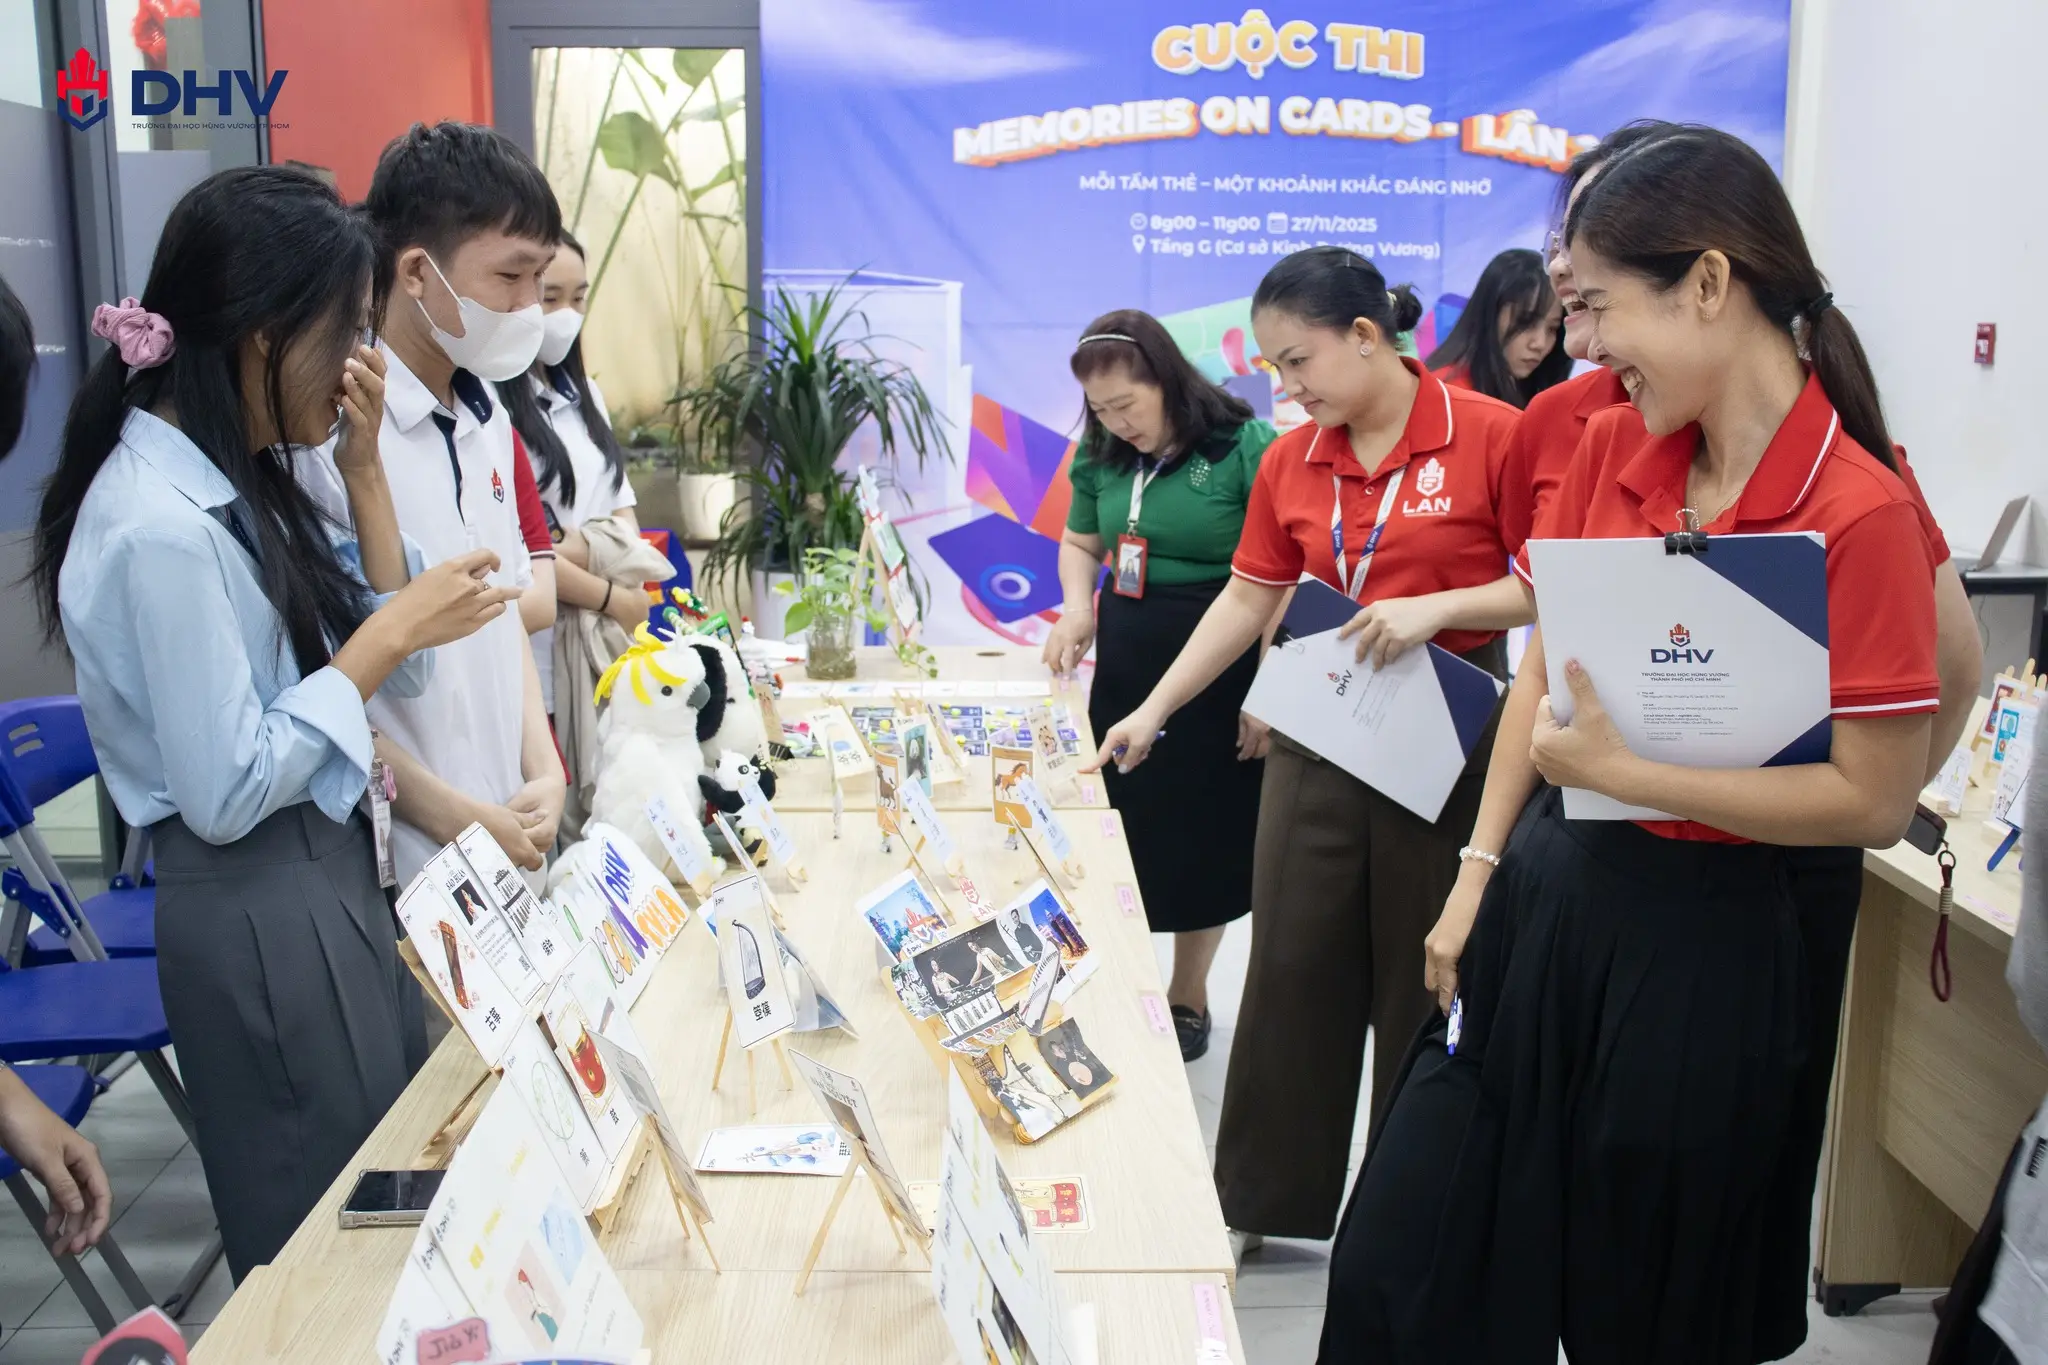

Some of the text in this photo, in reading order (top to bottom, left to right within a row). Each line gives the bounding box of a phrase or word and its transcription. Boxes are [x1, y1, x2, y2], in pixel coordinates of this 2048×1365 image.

[1152, 8, 1425, 80] CUỘC THI
[953, 98, 1200, 167] MEMORIES
[1201, 96, 1272, 137] ON
[1279, 95, 1433, 140] CARDS
[1080, 171, 1115, 190] MỖI
[1120, 172, 1158, 191] TẤM
[1162, 172, 1197, 191] THẺ
[1214, 174, 1254, 194] MỘT
[1258, 174, 1336, 193] KHOẢNH
[1341, 174, 1390, 193] KHẮC
[1394, 177, 1446, 194] ĐÁNG
[1451, 178, 1491, 195] NHỚ
[1150, 215, 1197, 233] 8g00
[1213, 216, 1260, 234] 11g00
[1291, 215, 1377, 234] 27/11/2025
[1198, 240, 1212, 255] G
[1377, 242, 1440, 260] Vương)
[1402, 497, 1452, 514] LAN
[1650, 648, 1715, 664] DHV
[1335, 668, 1354, 697] DHV
[604, 840, 631, 906] DHV
